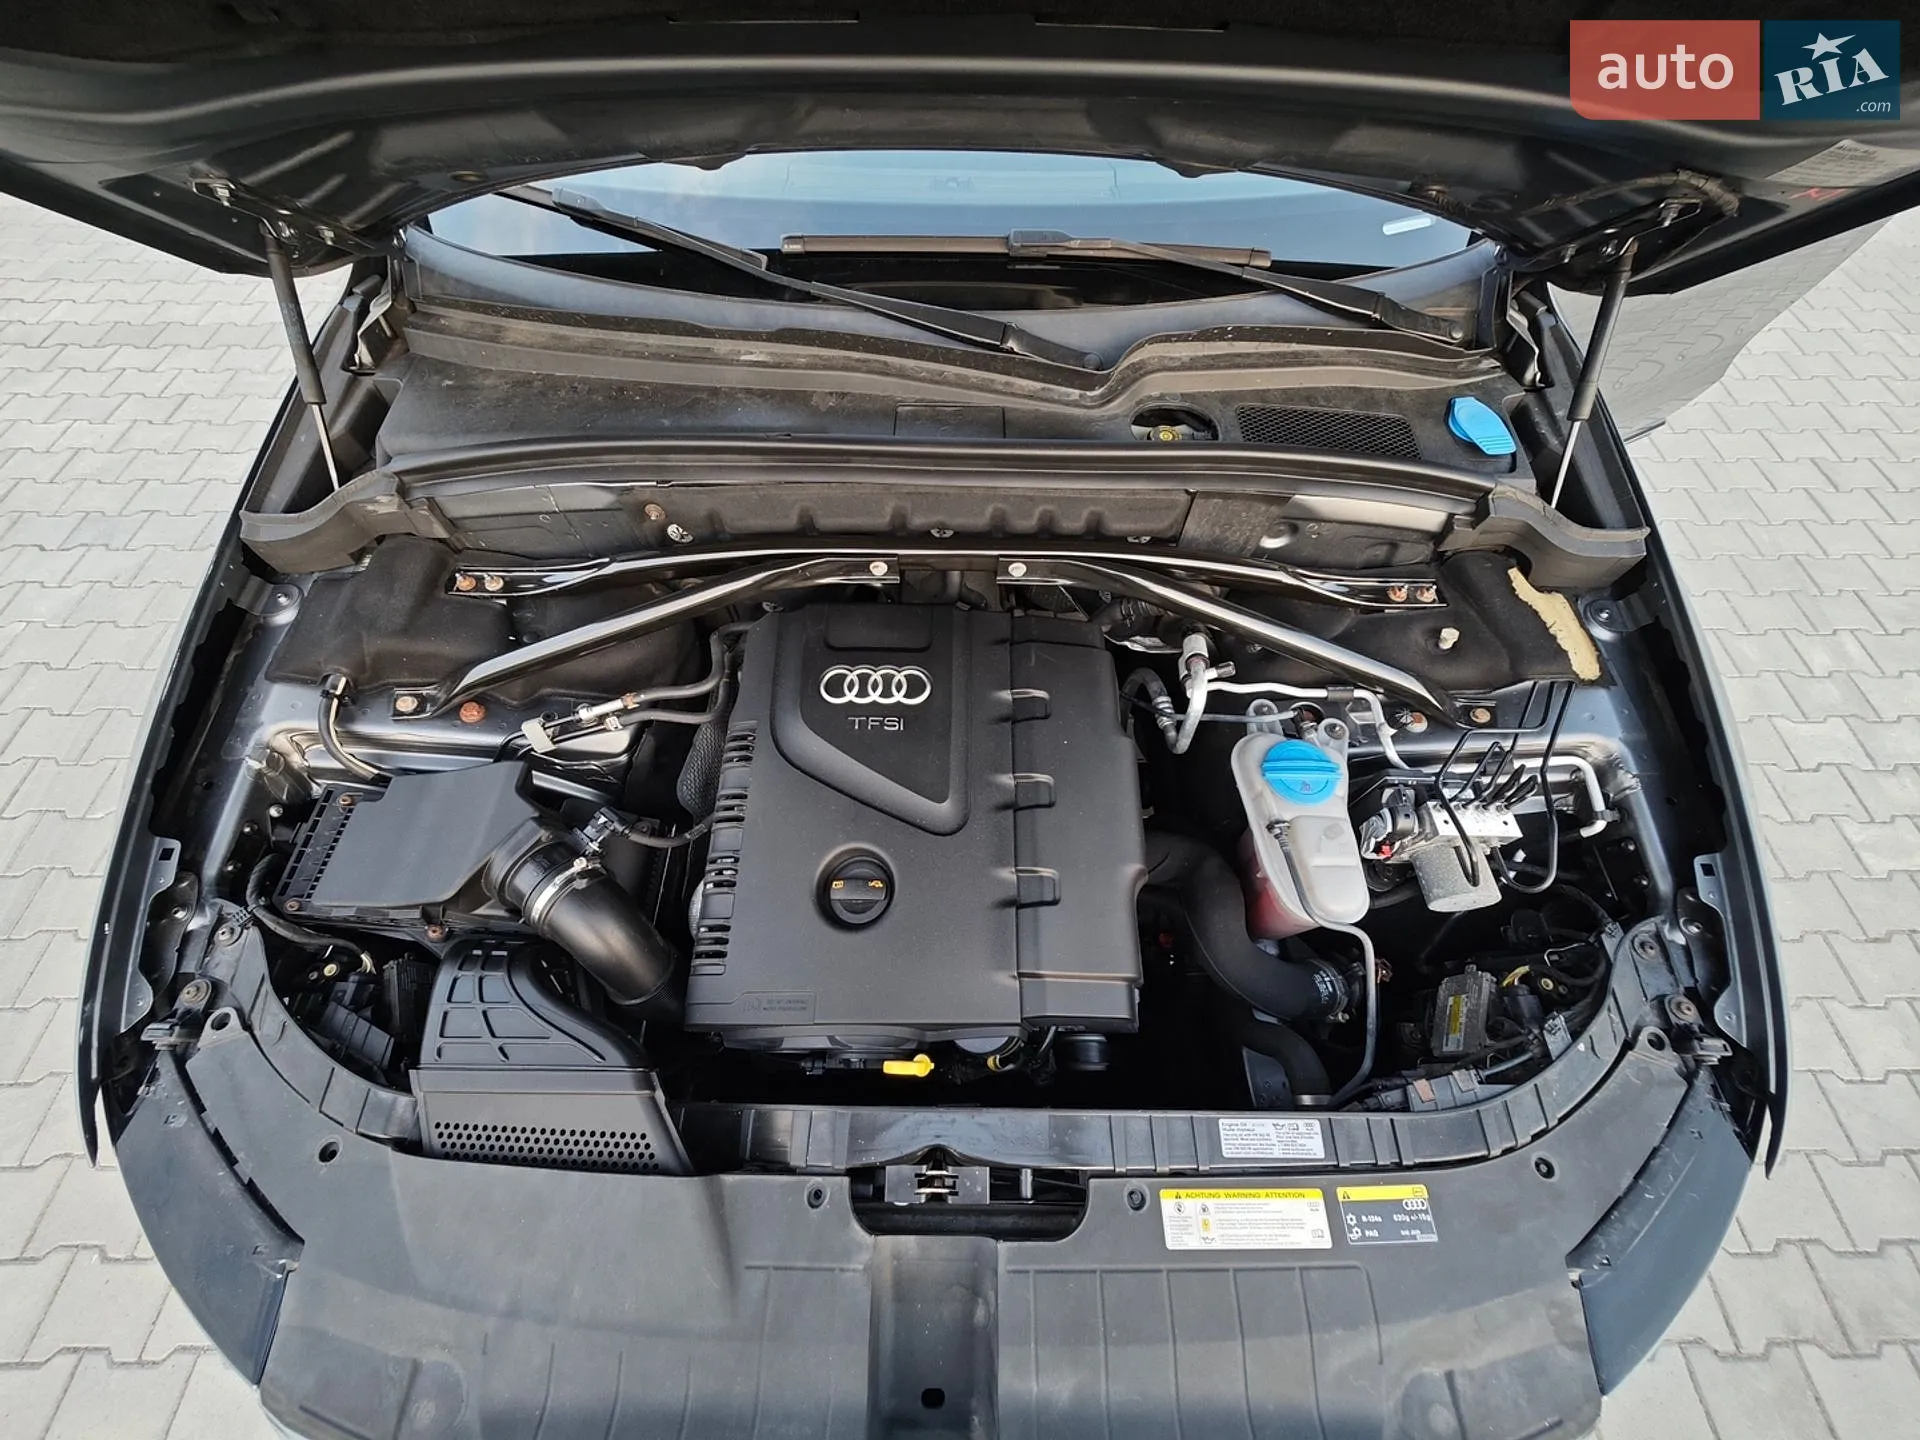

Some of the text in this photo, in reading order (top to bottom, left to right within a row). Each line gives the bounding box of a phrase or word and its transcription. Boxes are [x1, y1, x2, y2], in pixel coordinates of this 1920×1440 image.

[848, 716, 905, 732] TFSI
[1184, 1191, 1306, 1199] ACHTUNG WARNING ATTENTION
